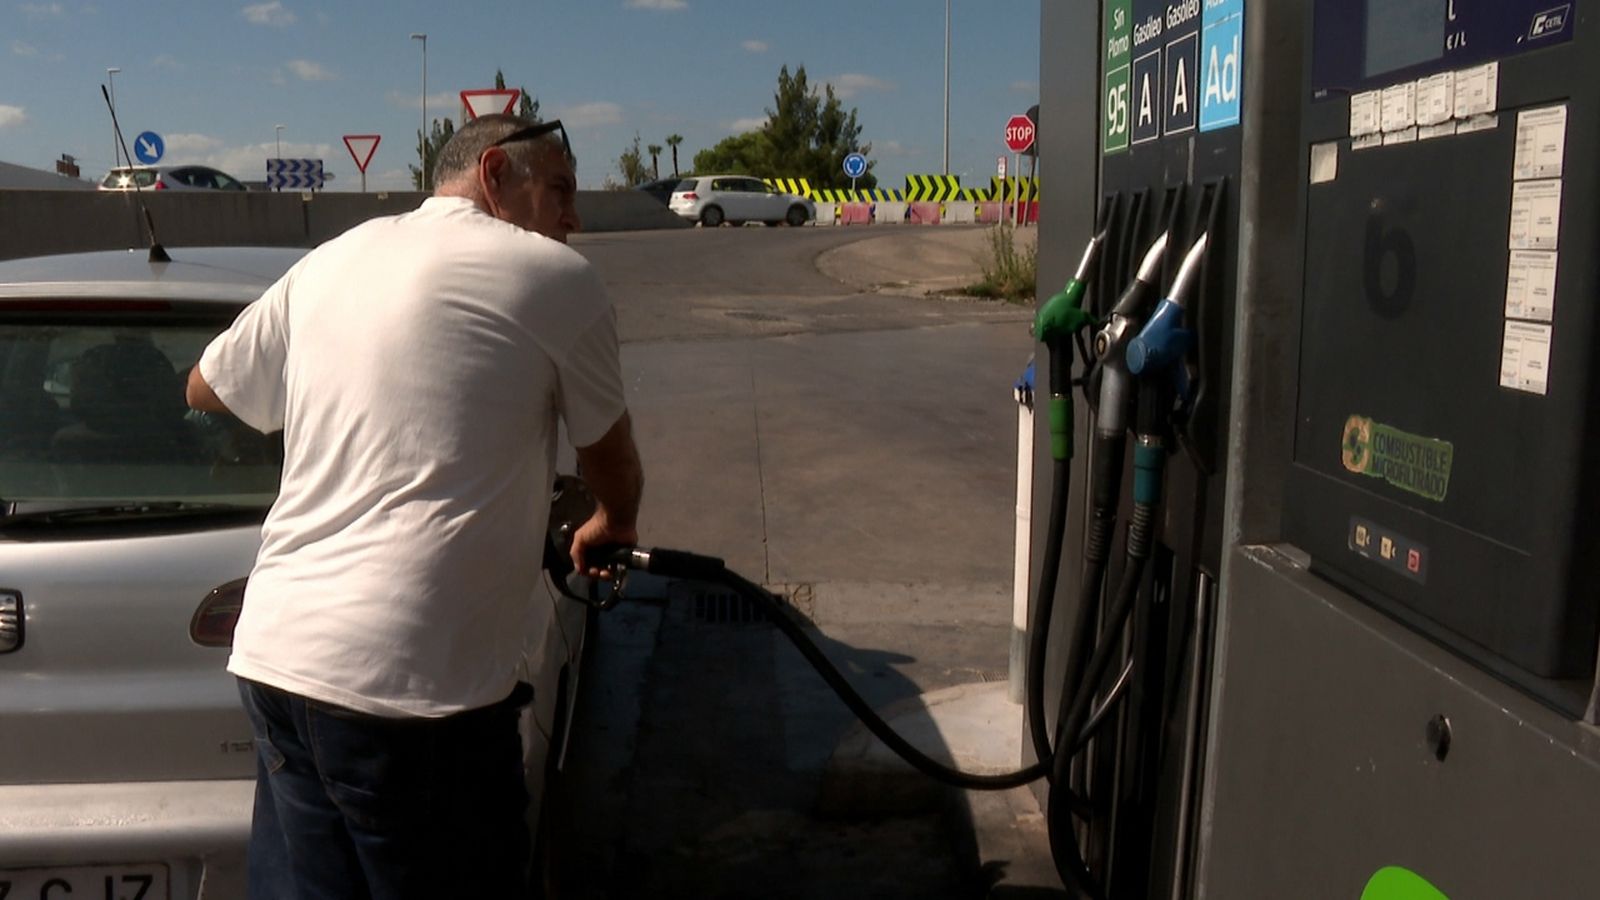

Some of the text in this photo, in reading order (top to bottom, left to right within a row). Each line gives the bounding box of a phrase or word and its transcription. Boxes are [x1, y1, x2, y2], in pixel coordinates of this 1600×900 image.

[1113, 8, 1125, 30] Sin
[1134, 15, 1162, 47] Gasóleo
[1108, 34, 1129, 60] Plomo
[1172, 57, 1188, 116] A
[1204, 34, 1238, 108] Ad
[1108, 83, 1127, 136] 95
[1138, 72, 1152, 127] A
[1006, 126, 1032, 141] STOP
[1364, 213, 1416, 321] 6
[1373, 432, 1448, 474] COMBUSTIBLE
